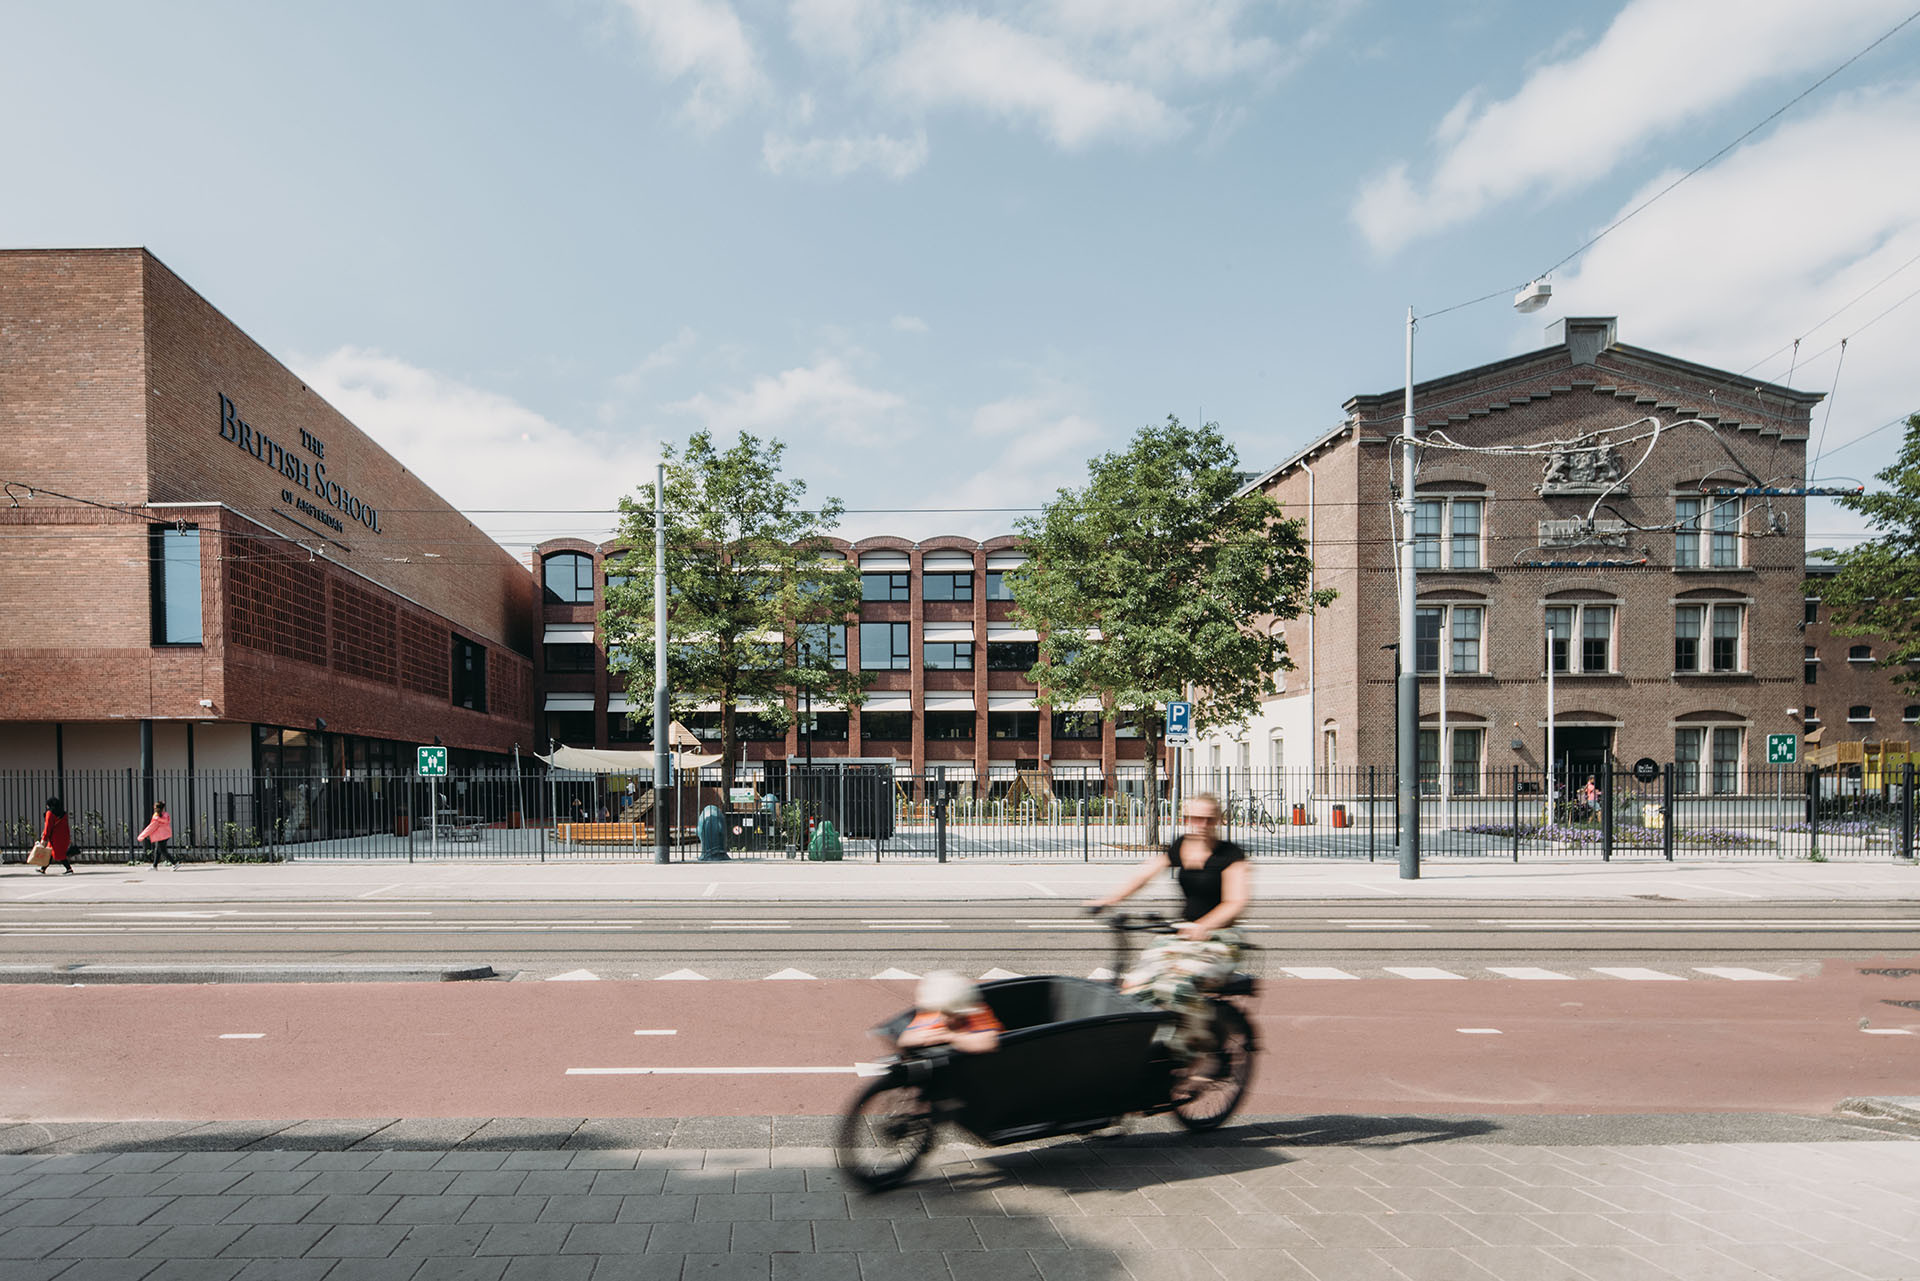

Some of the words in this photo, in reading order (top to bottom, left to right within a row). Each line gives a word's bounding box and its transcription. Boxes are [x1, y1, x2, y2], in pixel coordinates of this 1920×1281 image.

[299, 427, 325, 459] THE
[218, 392, 312, 490] BRITISH
[315, 462, 382, 534] SCHOOL
[296, 497, 344, 534] AMSTERDAM
[1173, 705, 1185, 722] P
